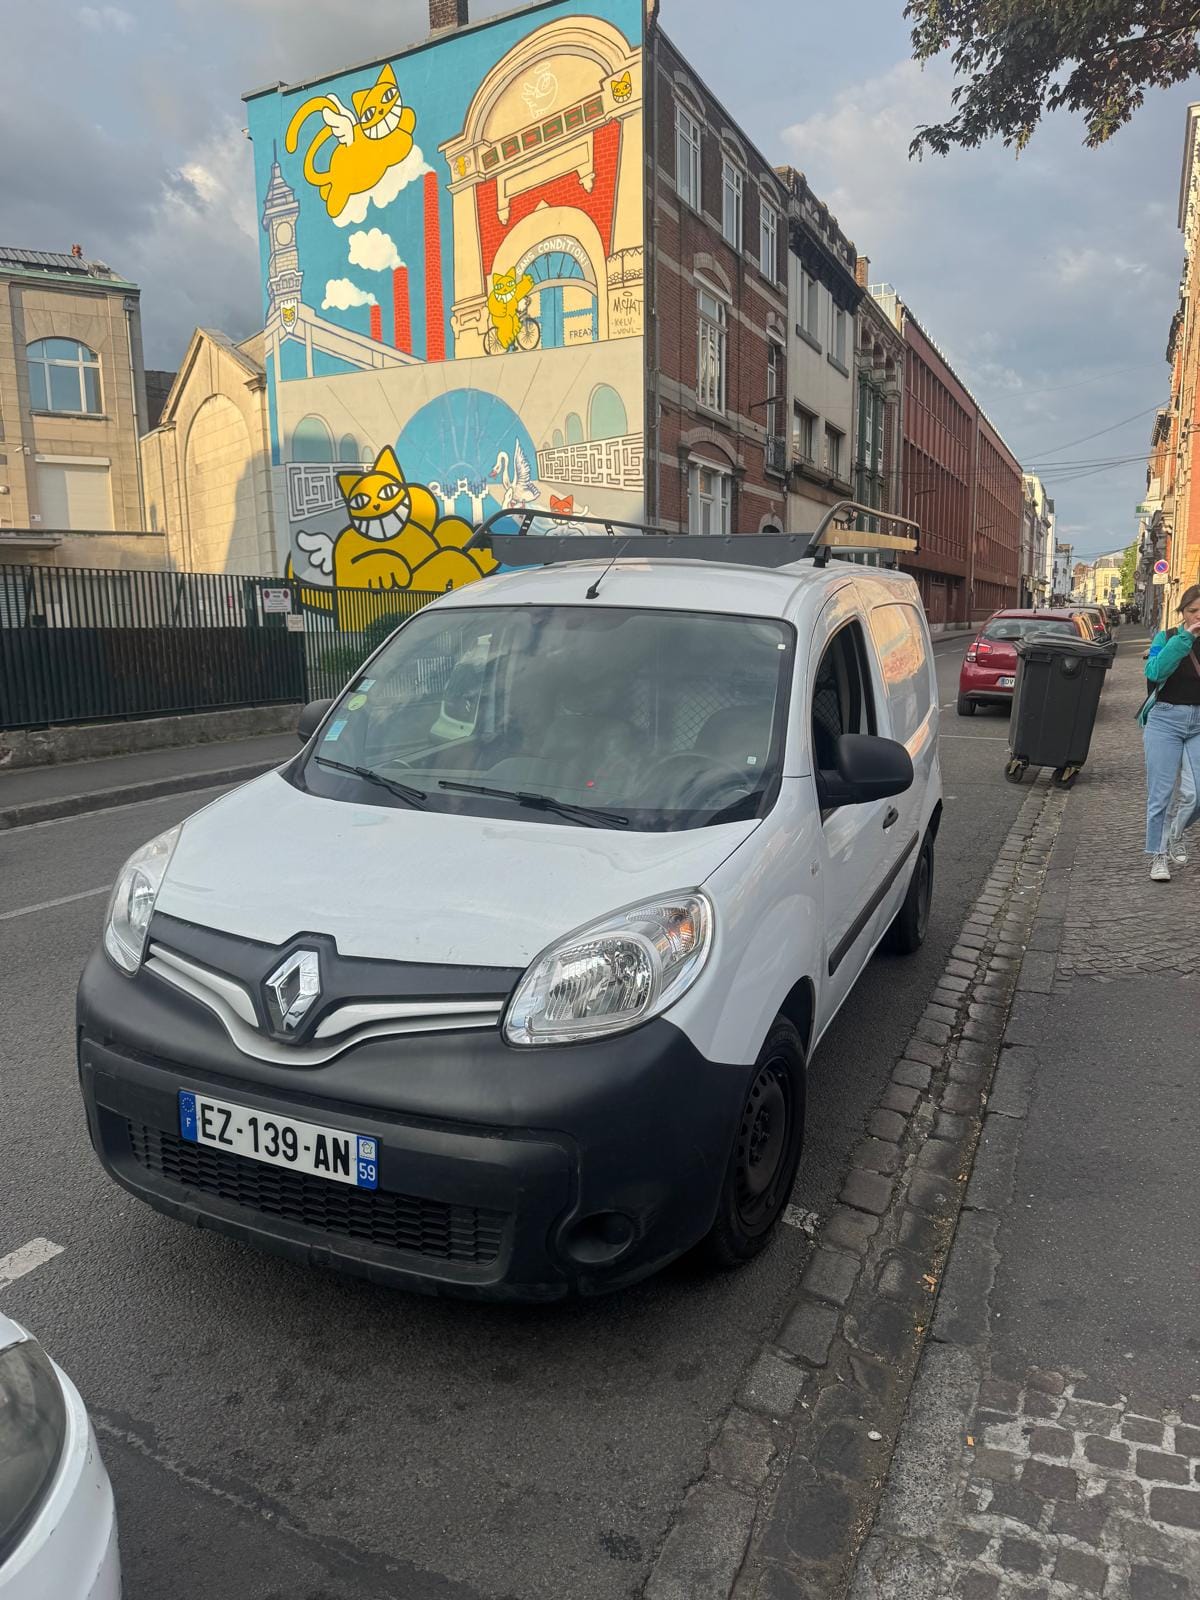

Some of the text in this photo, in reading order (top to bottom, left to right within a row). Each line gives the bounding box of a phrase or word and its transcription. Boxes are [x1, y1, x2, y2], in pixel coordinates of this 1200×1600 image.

[516, 252, 535, 276] SANS
[185, 1117, 192, 1128] F
[200, 1102, 350, 1177] EZ-139-AN
[358, 1162, 376, 1182] 59
